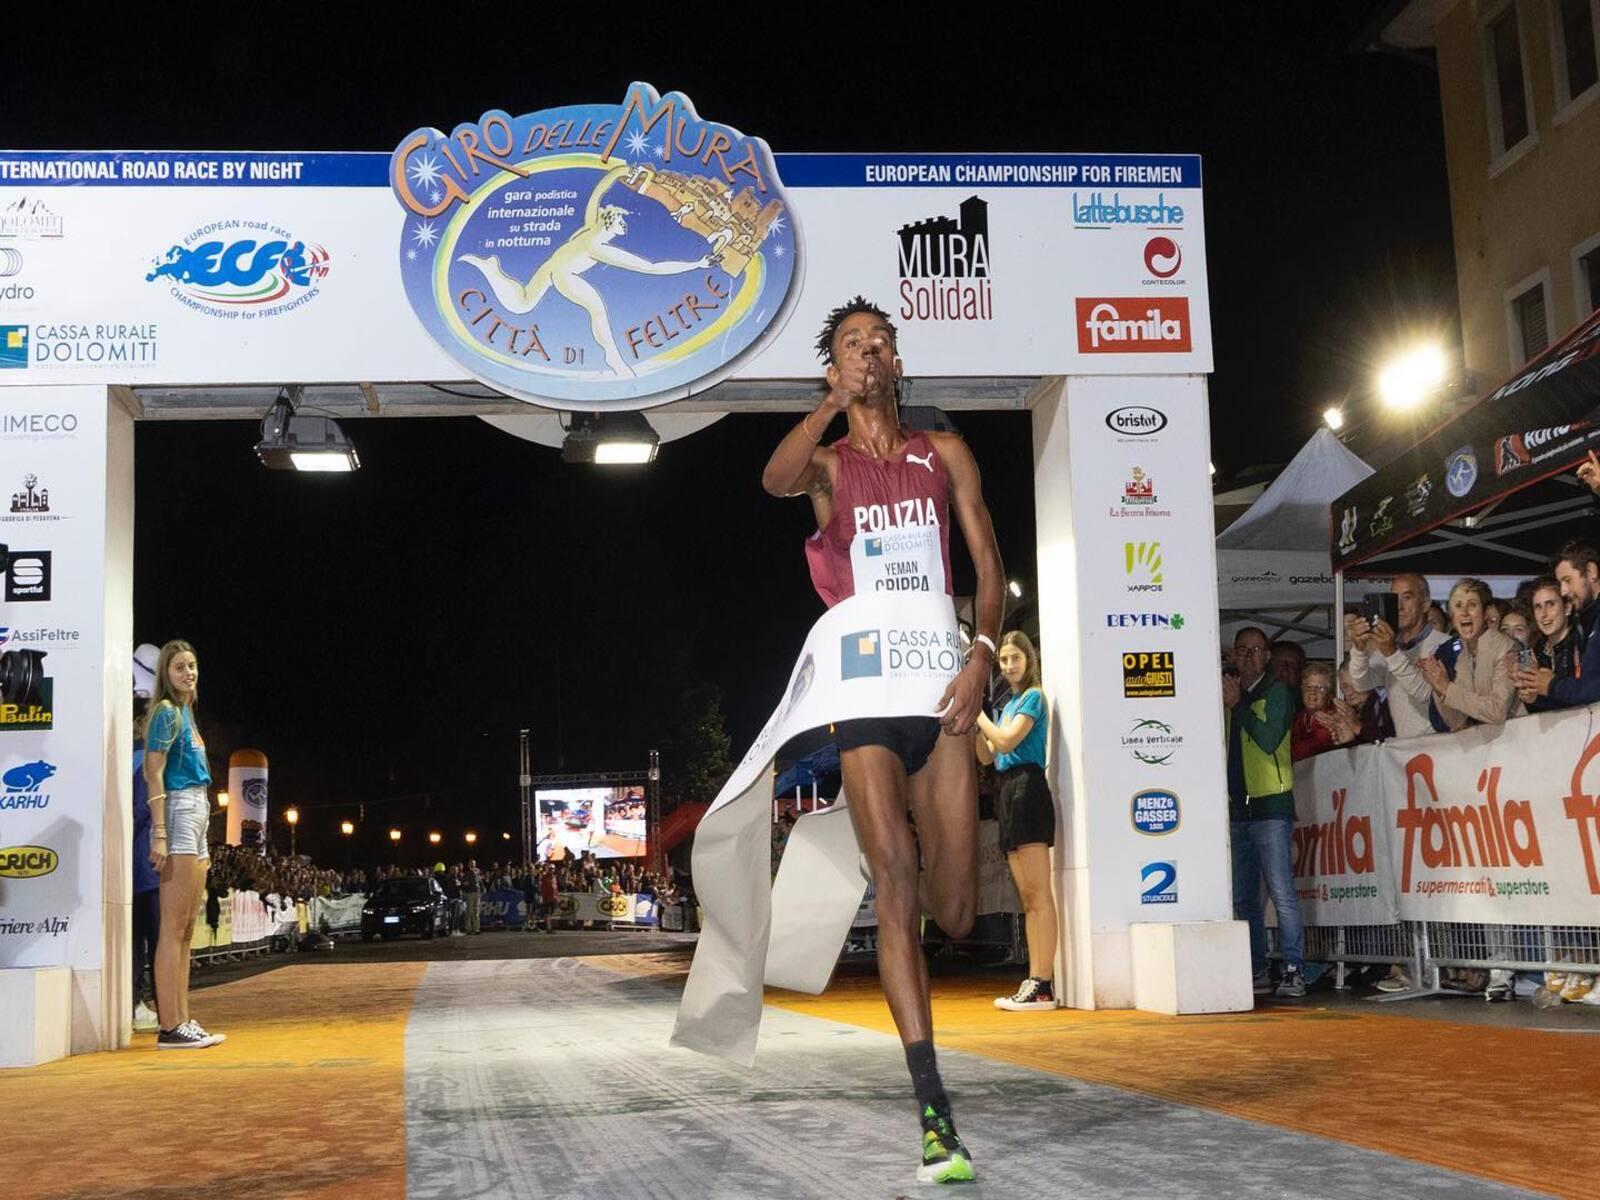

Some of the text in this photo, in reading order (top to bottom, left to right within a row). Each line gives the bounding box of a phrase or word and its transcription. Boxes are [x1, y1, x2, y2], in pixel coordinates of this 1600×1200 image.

[394, 89, 768, 217] GIRO DELLE MURA
[122, 161, 170, 180] ROAD
[174, 161, 218, 180] RACE
[222, 161, 246, 180] BY
[251, 161, 304, 180] NIGHT
[865, 165, 1182, 184] EUROPEAN CHAMPIONSHIP FOR FIREMEN
[505, 189, 578, 203] gara podistica
[488, 204, 575, 218] internazionale
[1072, 192, 1185, 223] lattebusche
[183, 219, 293, 247] EUROPEAN road race
[509, 219, 561, 233] su strada
[485, 236, 551, 248] in notturna
[898, 233, 991, 280] MURA
[170, 286, 321, 320] CHAMPIONSHIP for FIREFIGHTERS
[899, 279, 993, 321] Solidali
[457, 274, 731, 367] CITTÀ DI FELTRE
[1085, 302, 1181, 348] famila
[35, 324, 158, 340] CASSA RURALE
[35, 341, 157, 362] DOLOMITI
[3, 413, 78, 433] IMECO
[1116, 412, 1157, 427] bristot
[853, 497, 941, 534] POLIZIA
[884, 560, 919, 576] YEMAN
[12, 585, 44, 595] sportful
[1106, 613, 1169, 627] BEYFIN
[12, 628, 80, 641] AssiFeltre
[887, 629, 941, 647] CASSA
[1123, 652, 1174, 670] OPEL
[1134, 810, 1178, 823] GASSER
[1396, 752, 1544, 894] famila
[1330, 883, 1378, 903] superstore
[1496, 878, 1550, 900] superstore
[42, 916, 70, 937] Alpi
